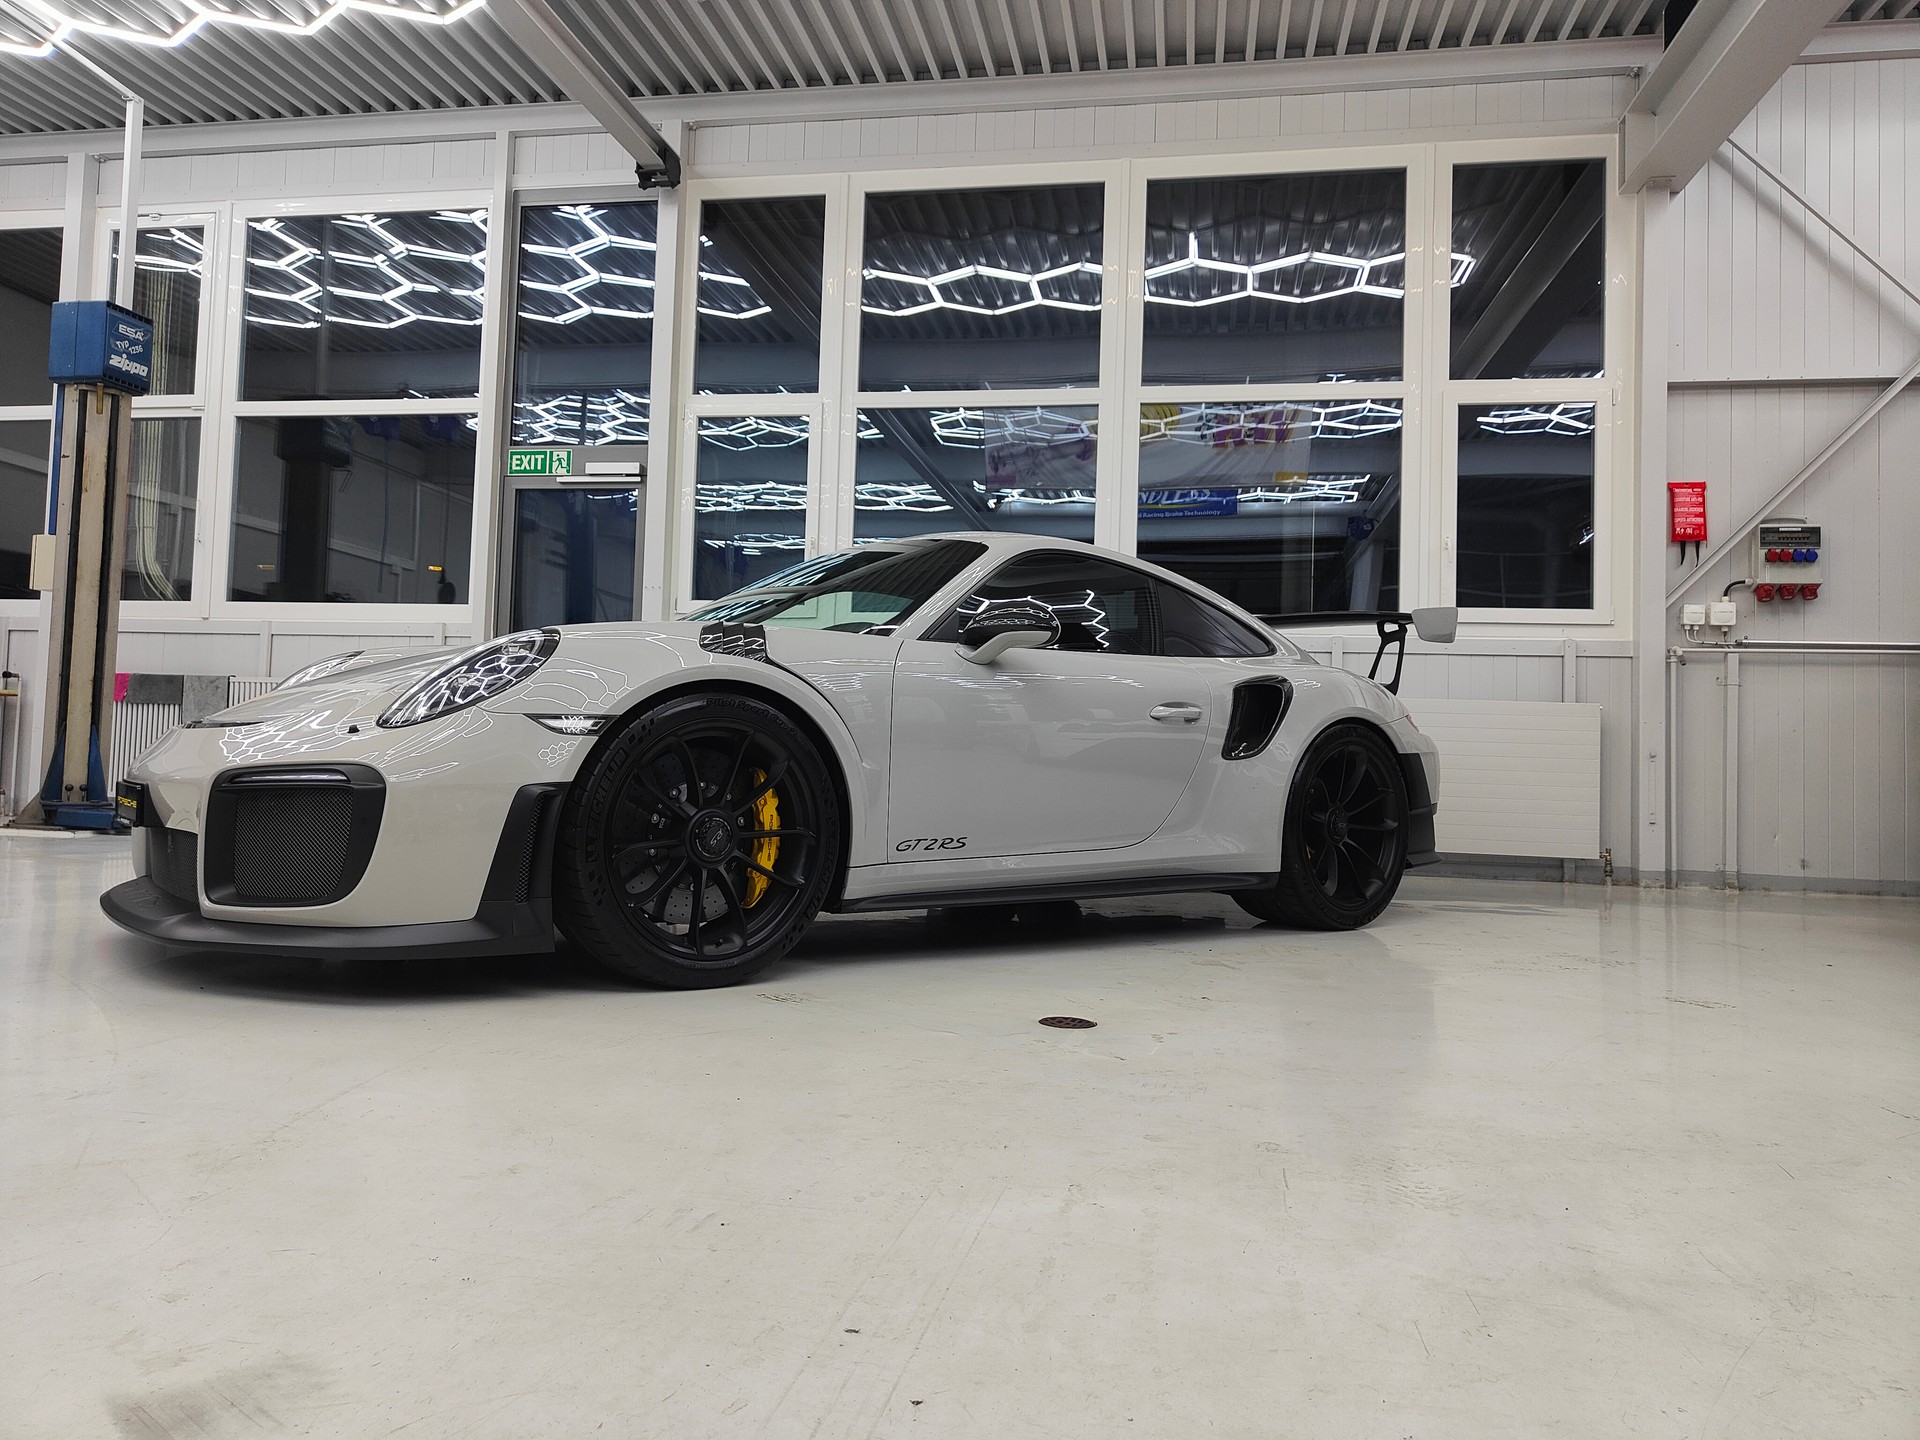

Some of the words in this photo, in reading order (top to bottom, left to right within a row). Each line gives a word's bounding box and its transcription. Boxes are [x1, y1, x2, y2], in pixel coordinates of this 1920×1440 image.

[118, 323, 143, 341] ESA
[109, 354, 148, 377] zippo
[511, 454, 545, 471] EXIT
[705, 697, 736, 708] Pilot
[736, 700, 769, 718] Sport
[769, 713, 789, 730] Cup
[789, 727, 798, 737] 2
[587, 747, 628, 841] MICHELIN
[766, 814, 774, 862] POCHE
